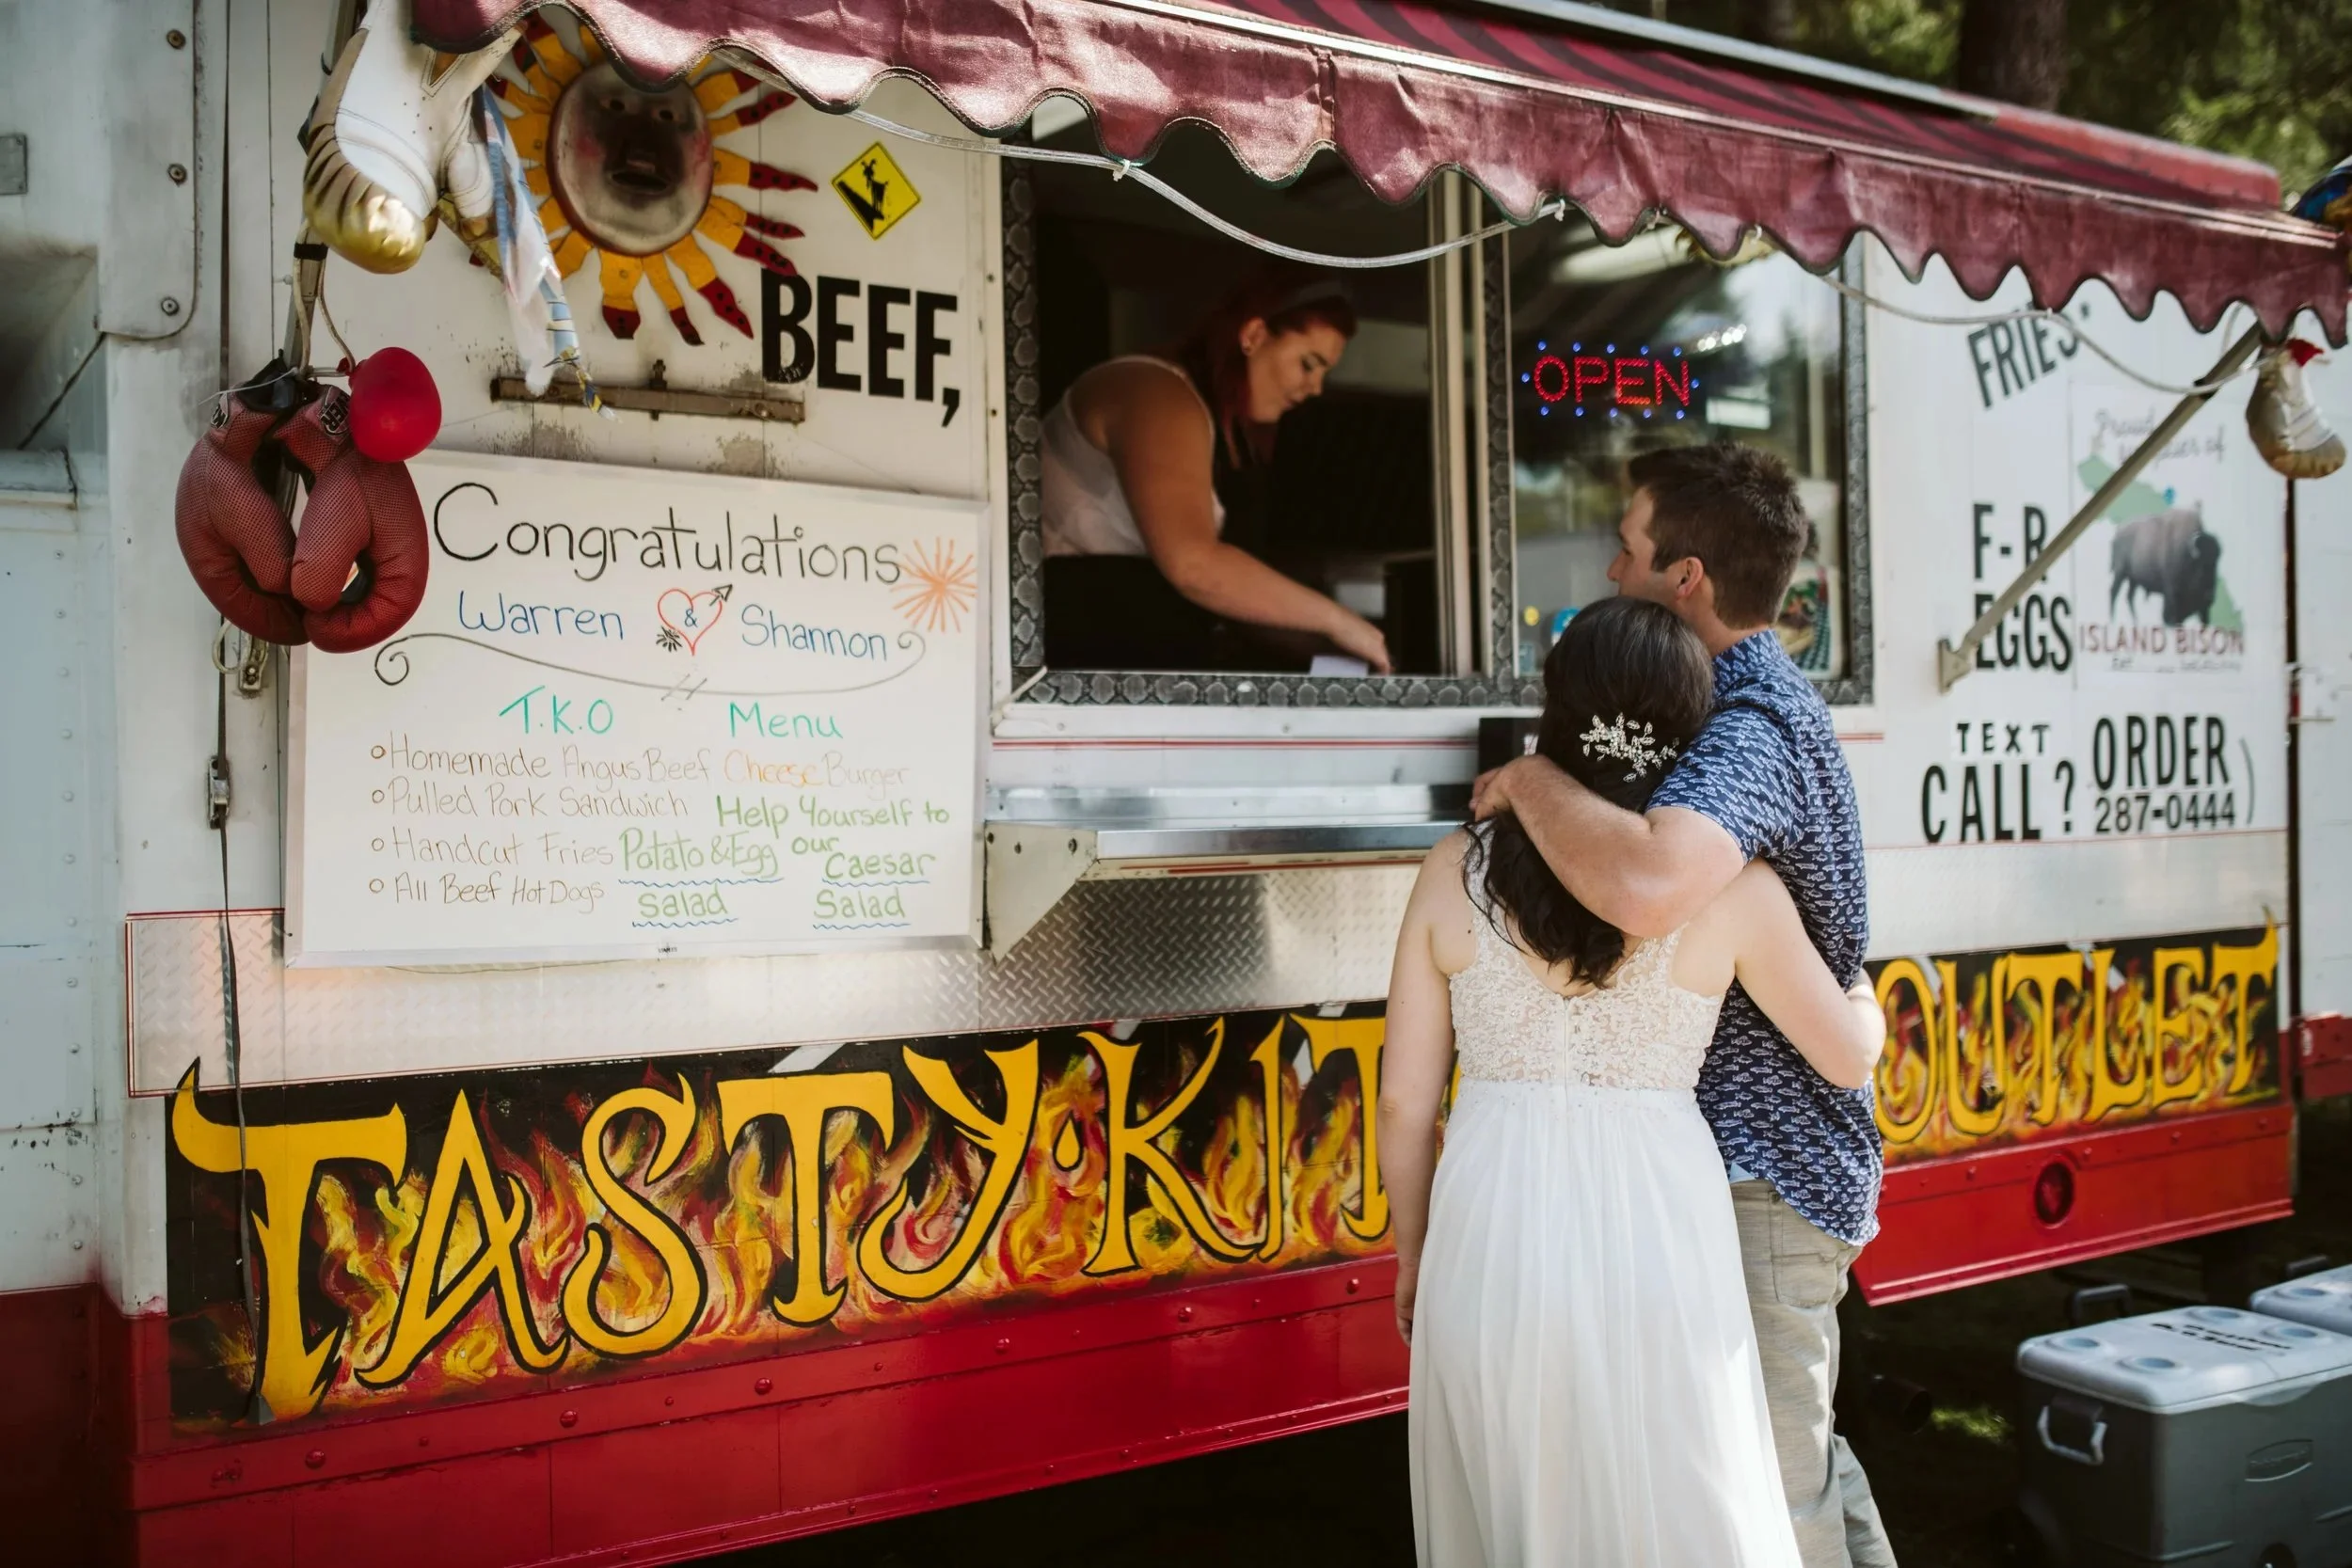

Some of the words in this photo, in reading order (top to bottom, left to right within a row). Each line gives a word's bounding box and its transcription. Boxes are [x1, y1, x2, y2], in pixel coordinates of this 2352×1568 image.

[761, 266, 960, 428] BEEF,
[1534, 355, 1690, 406] OPEN
[434, 482, 901, 582] Congratulations
[458, 590, 625, 640] Warren
[684, 607, 698, 627] &
[741, 604, 887, 661] Shannon
[1973, 593, 2073, 673] EGGS
[2079, 624, 2167, 654] ISLAND
[2175, 625, 2246, 657] BISON
[499, 685, 614, 736] T.K.O
[729, 702, 843, 738] Menu
[1957, 721, 2051, 753] TEXT
[2092, 714, 2230, 791] ORDER
[389, 731, 552, 779] Homemade
[562, 744, 642, 793] Angus
[643, 747, 711, 784] Beef
[723, 749, 824, 788] Cheese
[821, 750, 910, 801] Burger
[388, 775, 479, 817] Pulled
[485, 782, 549, 817] Pork
[559, 786, 690, 818] Sandwich
[716, 794, 789, 839] Help
[799, 794, 913, 829] Yourself
[923, 800, 950, 824] to
[2095, 791, 2235, 834] 287-0444
[391, 825, 525, 866] Handcut
[536, 832, 614, 866] Fries
[618, 826, 705, 872] Potato
[791, 834, 840, 855] our
[824, 852, 937, 879] Caesar
[394, 871, 427, 904] All
[438, 870, 502, 905] Beef
[512, 875, 545, 906] Hot
[548, 879, 606, 915] Dogs
[813, 888, 906, 919] Salad
[1874, 905, 2279, 1145] OUTLET
[171, 1037, 1040, 1424] TASTY
